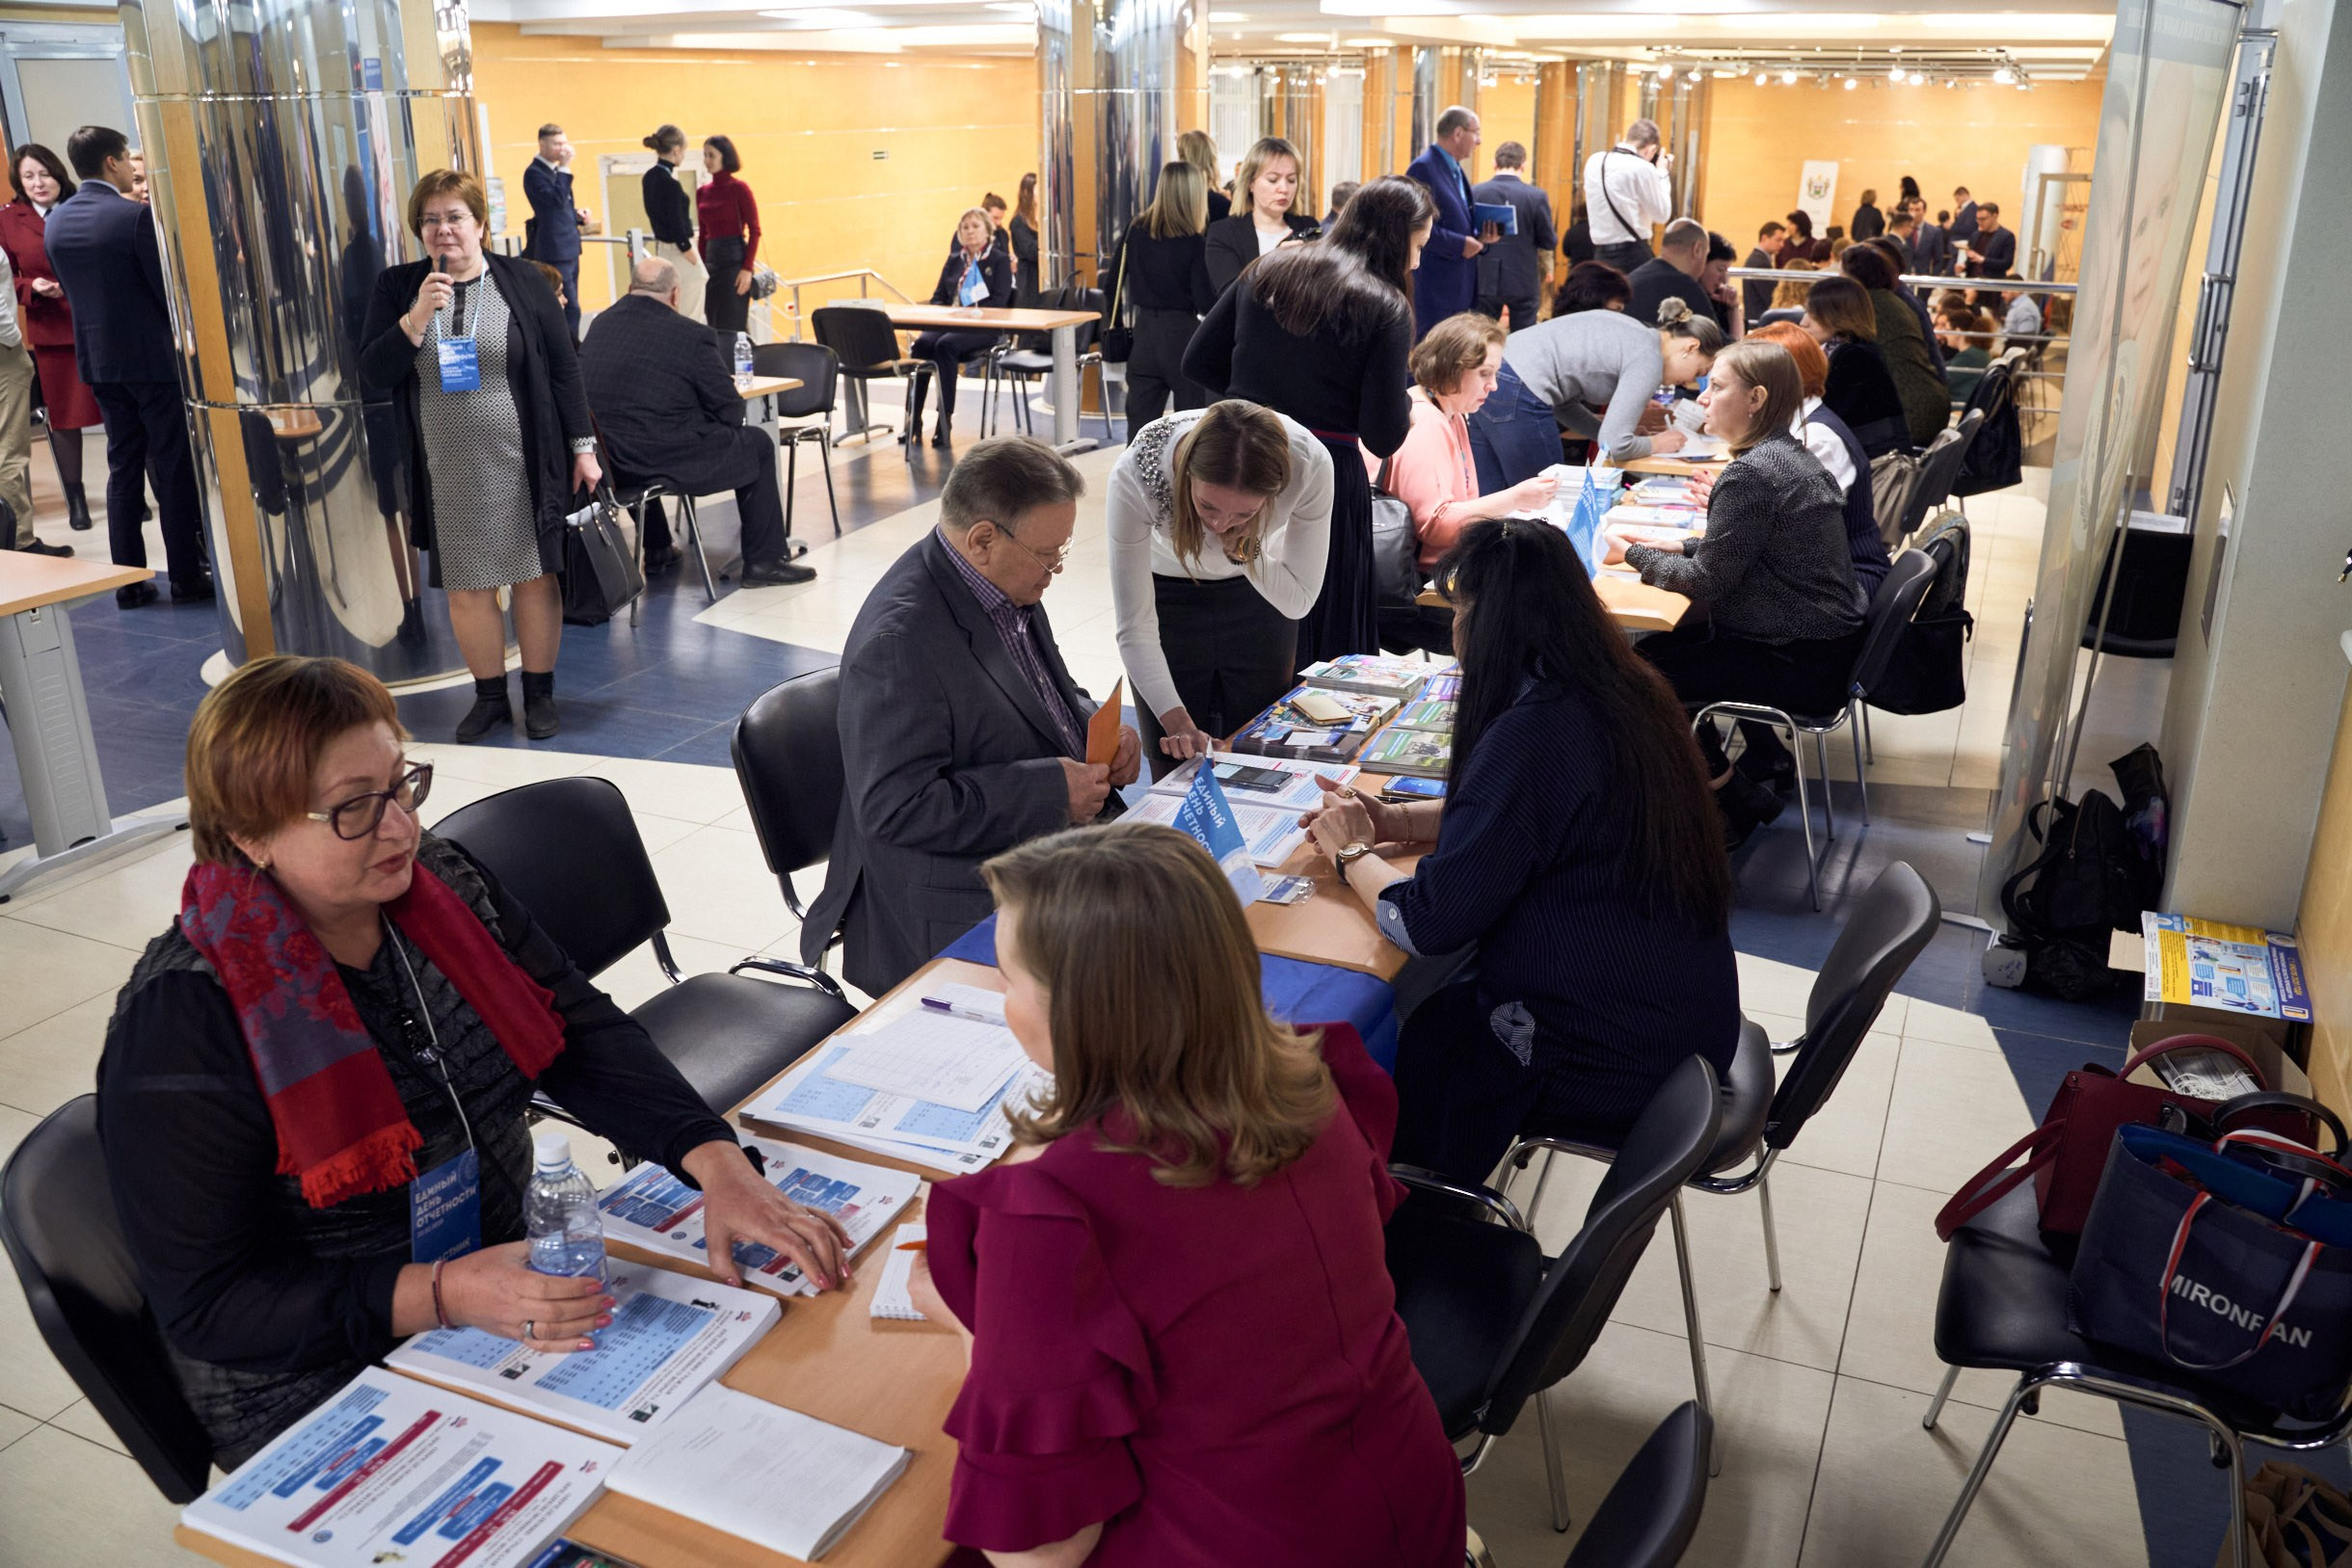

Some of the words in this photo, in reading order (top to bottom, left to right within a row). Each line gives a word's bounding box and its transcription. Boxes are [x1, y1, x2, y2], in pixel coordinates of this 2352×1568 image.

[1187, 790, 1204, 815] ЕНЬ
[1194, 776, 1226, 829] ЕДИНЫЙ
[414, 1170, 457, 1204] ЕДИНЫЙ
[416, 1195, 442, 1216] ДЕНЬ
[416, 1186, 477, 1228] ОТЧЕТНОСТИ
